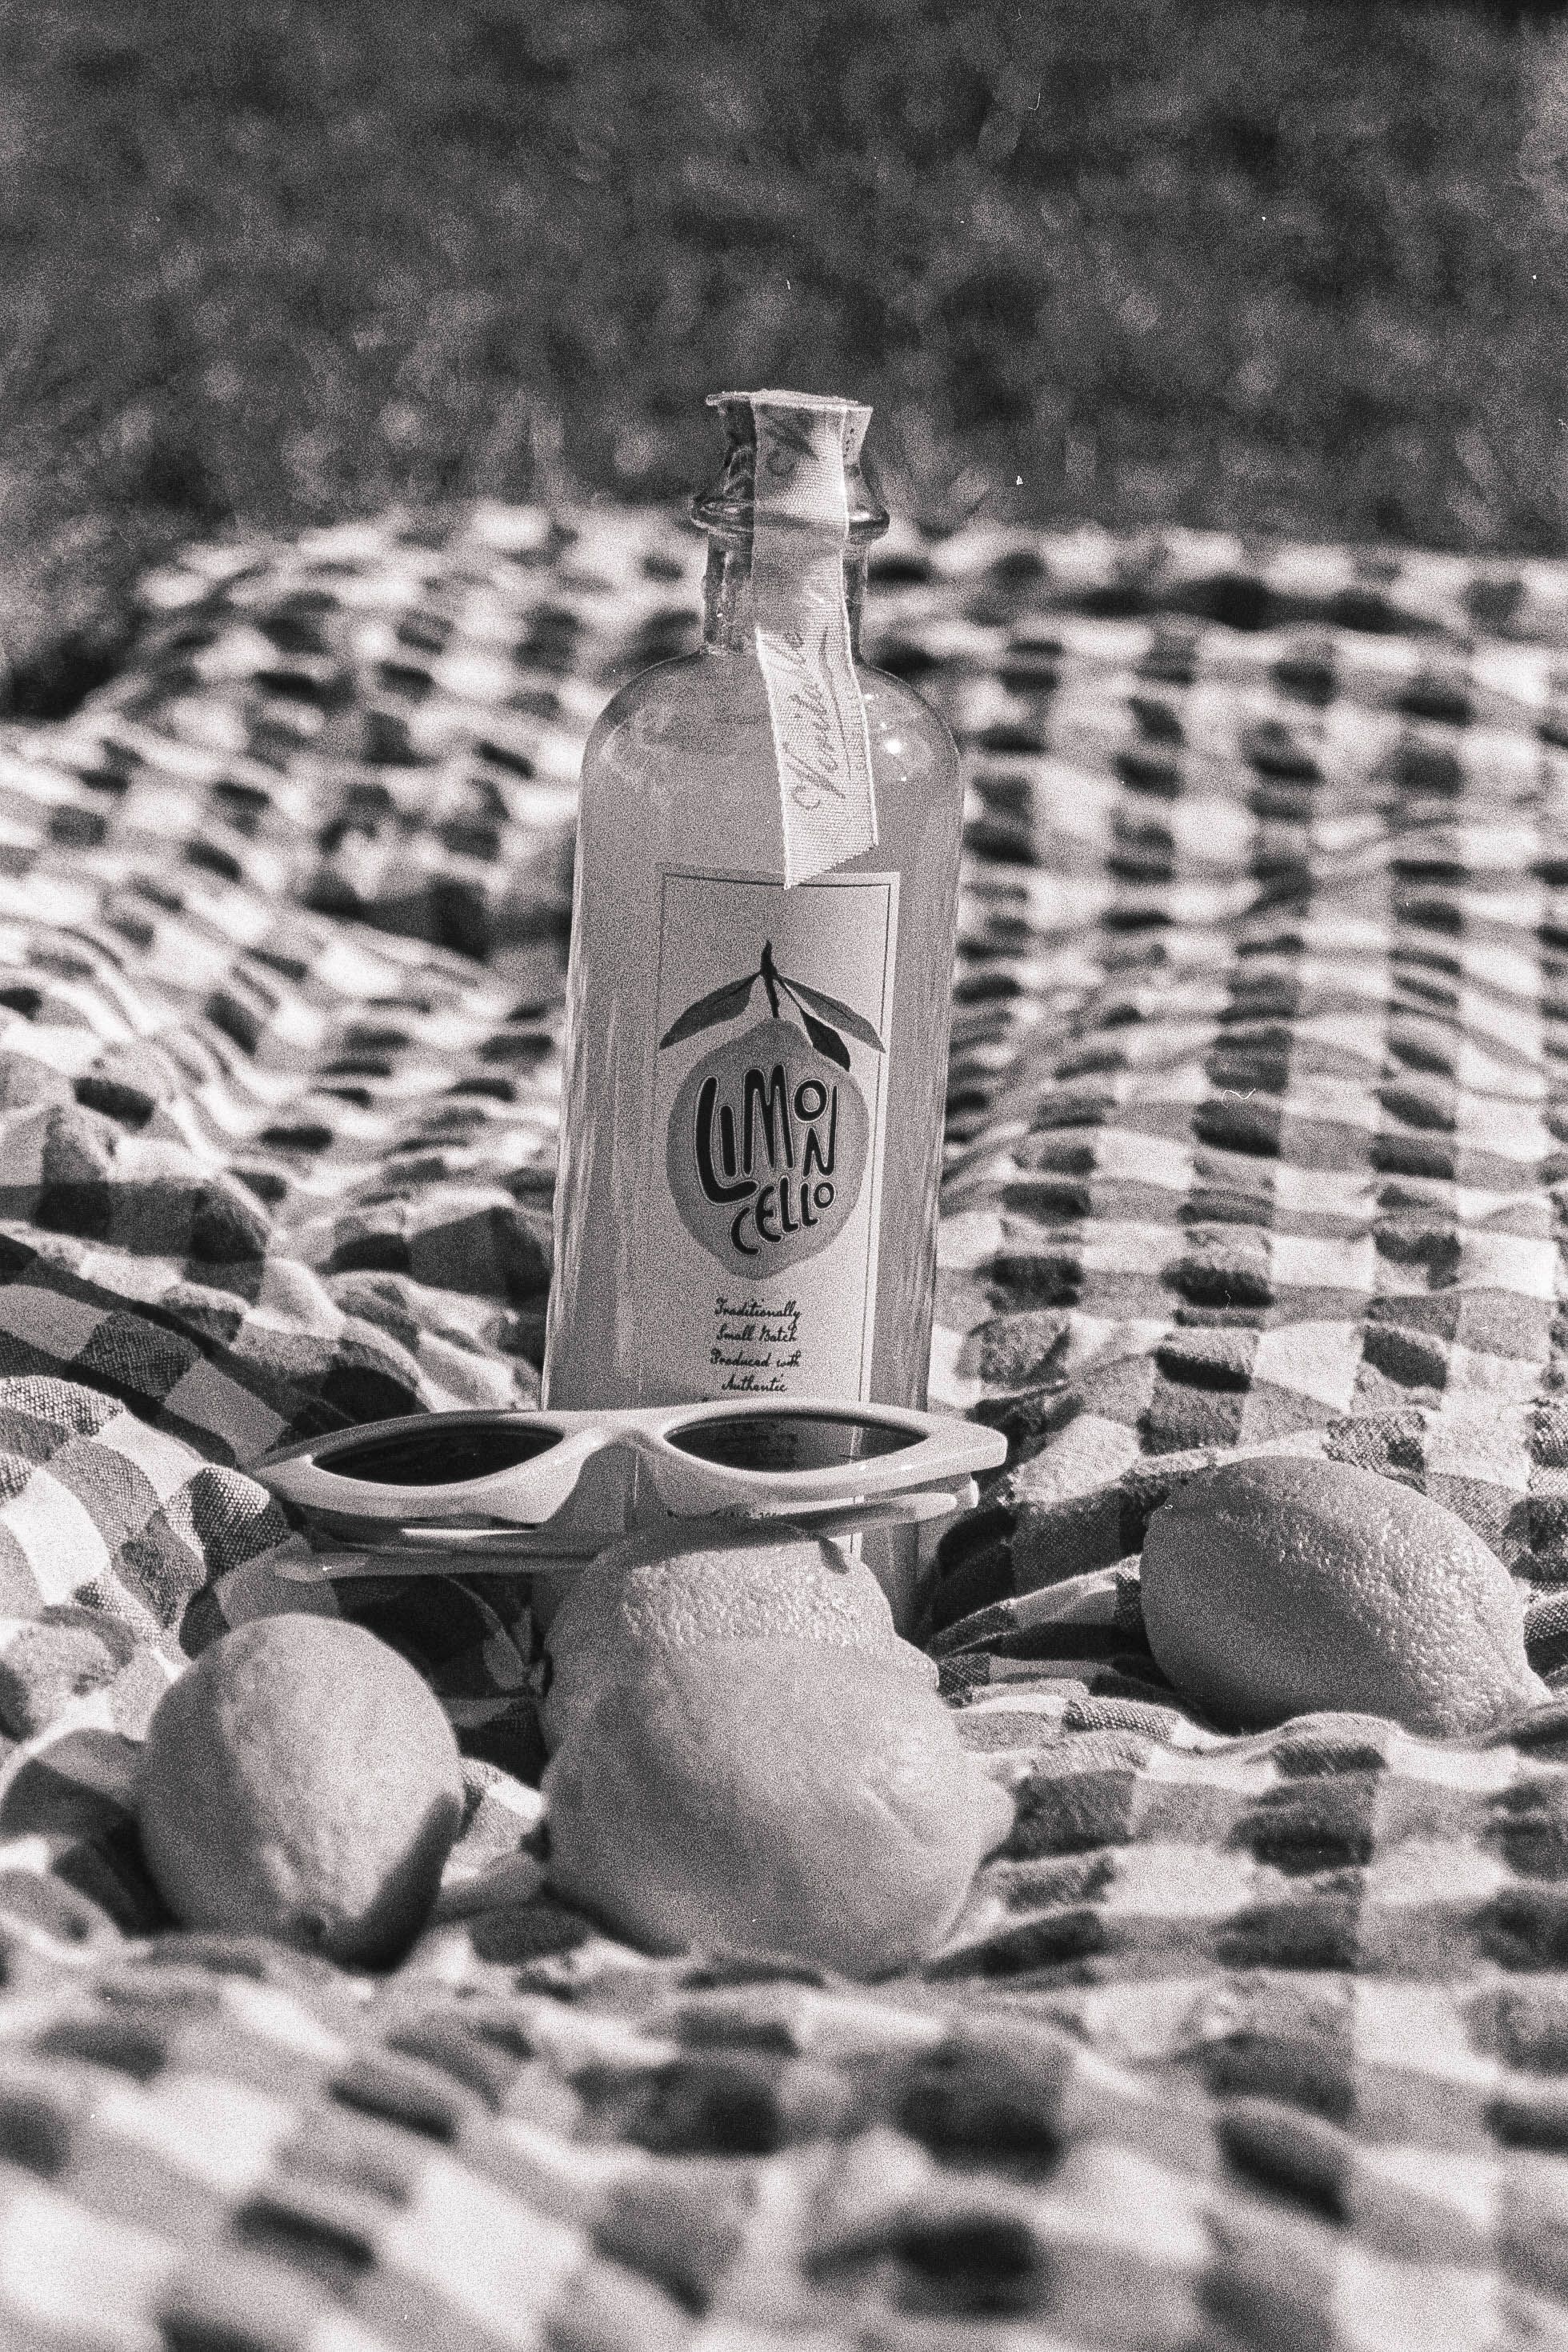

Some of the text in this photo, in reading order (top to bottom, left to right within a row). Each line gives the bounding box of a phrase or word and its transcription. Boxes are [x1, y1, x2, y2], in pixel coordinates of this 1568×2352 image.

[695, 1062, 838, 1204] LIMON
[730, 1175, 835, 1255] CELLO
[714, 1297, 801, 1331] Traditionally
[716, 1322, 798, 1342] Small Batch
[710, 1347, 802, 1367] Produced with
[722, 1373, 788, 1392] Authentic
